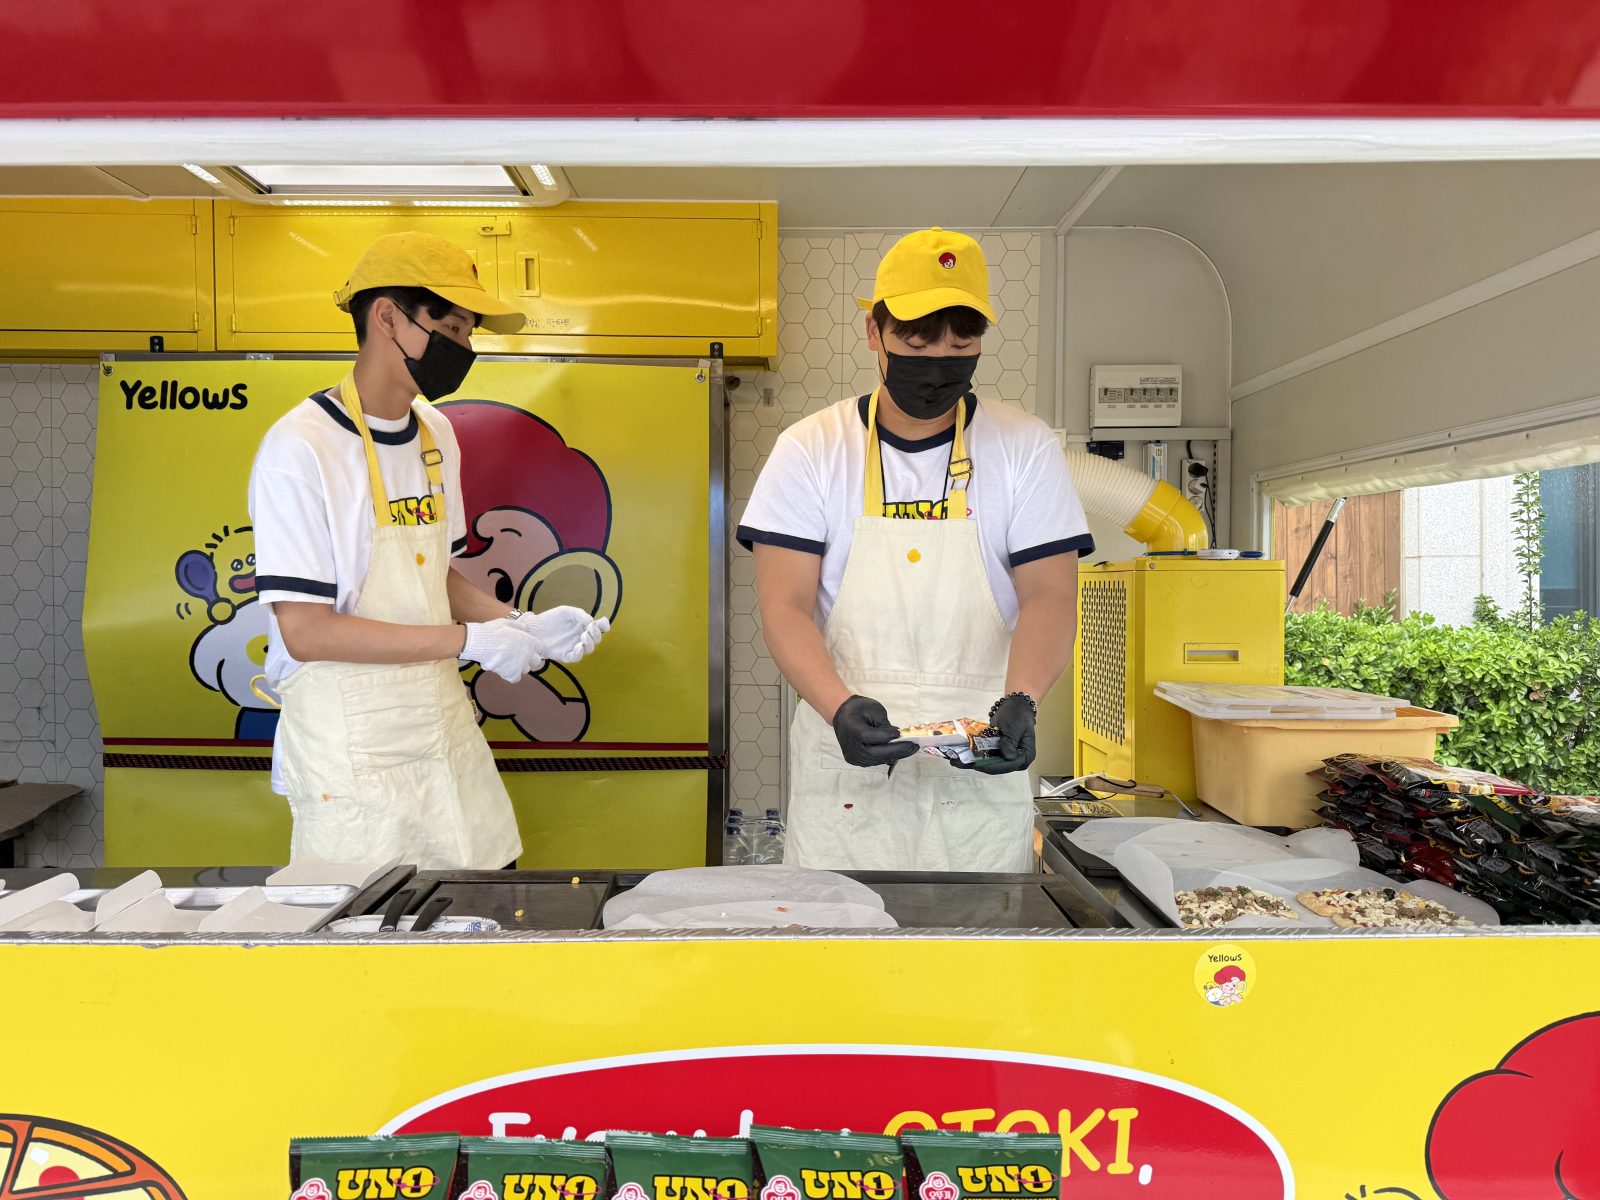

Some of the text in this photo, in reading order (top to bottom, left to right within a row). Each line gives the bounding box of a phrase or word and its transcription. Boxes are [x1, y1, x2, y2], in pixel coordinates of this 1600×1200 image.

[336, 1166, 435, 1200] UNO
[503, 1173, 598, 1200] UNO
[654, 1175, 749, 1200] UNO
[800, 1168, 895, 1200] UNO
[957, 1164, 1053, 1193] UNO
